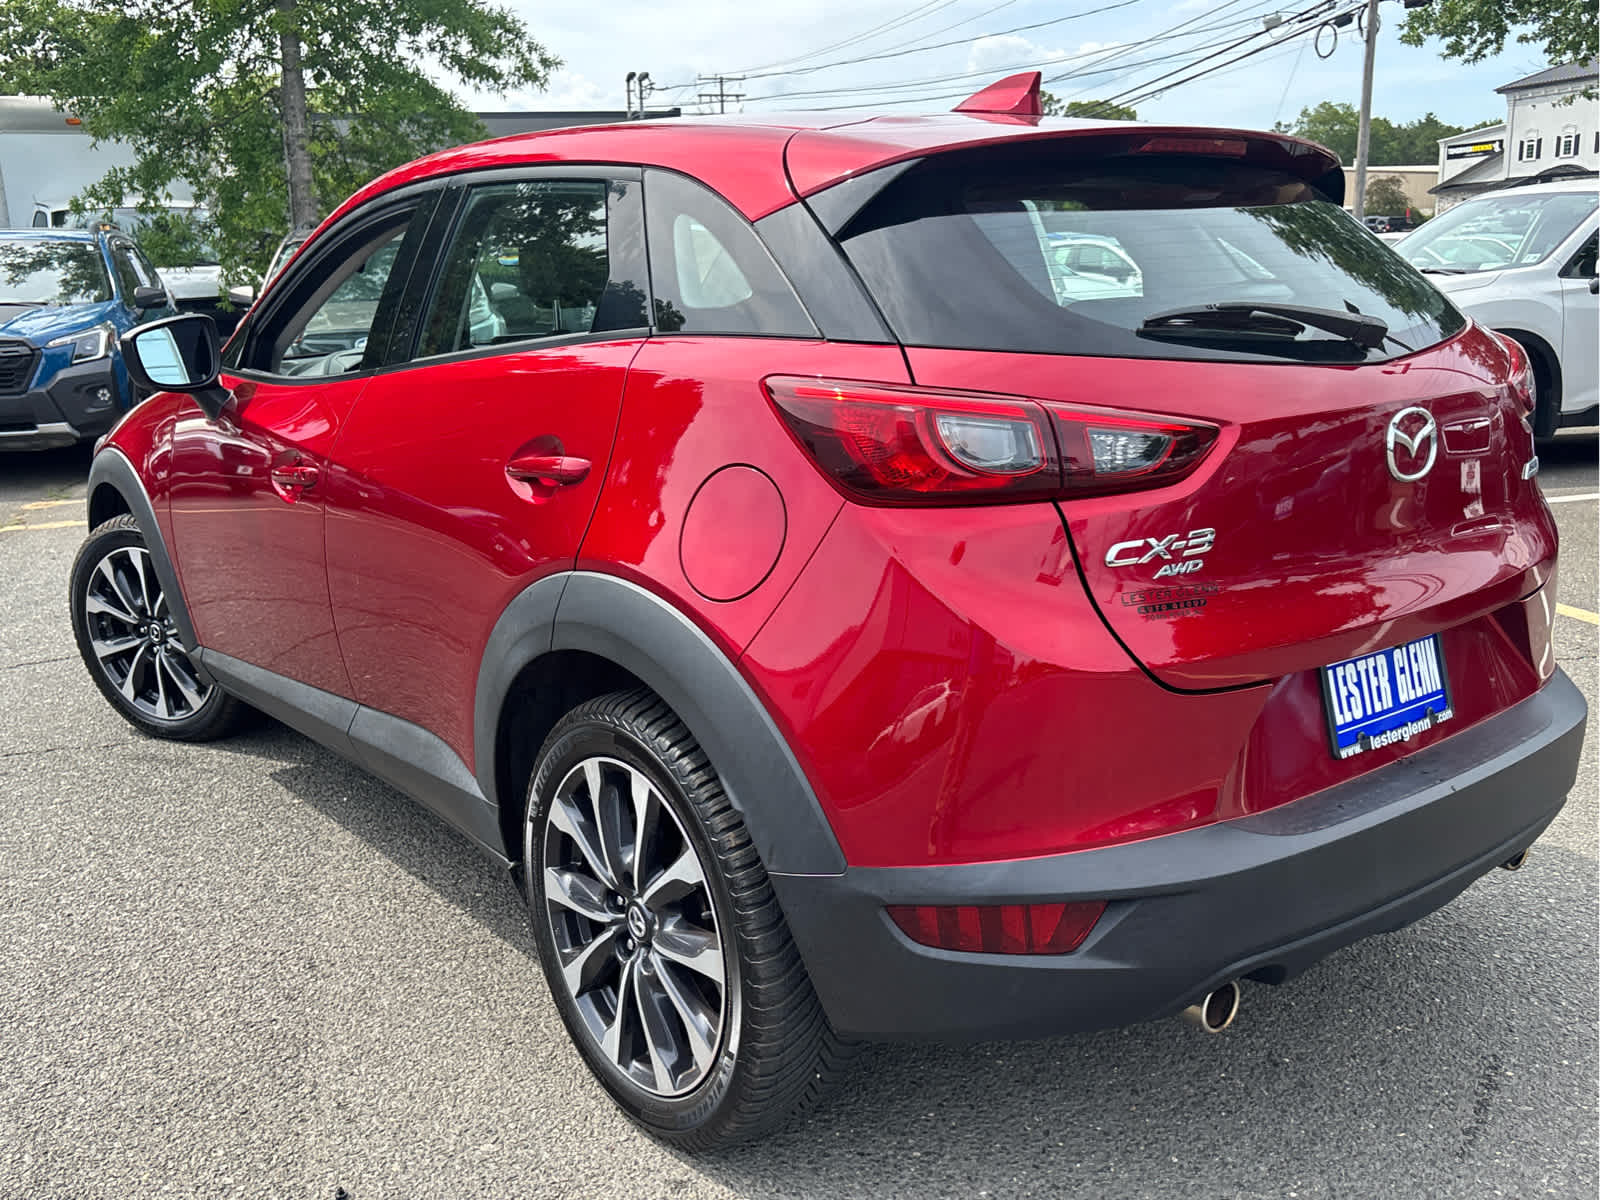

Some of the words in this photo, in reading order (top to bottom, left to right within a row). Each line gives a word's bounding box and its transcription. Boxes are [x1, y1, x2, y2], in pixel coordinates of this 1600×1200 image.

[1105, 528, 1216, 567] CX-3
[1152, 559, 1204, 580] AWD
[1121, 590, 1172, 604] LESTER
[1327, 654, 1393, 726] LESTER
[1393, 637, 1442, 704] GLENN
[1369, 719, 1431, 750] lesterglenn
